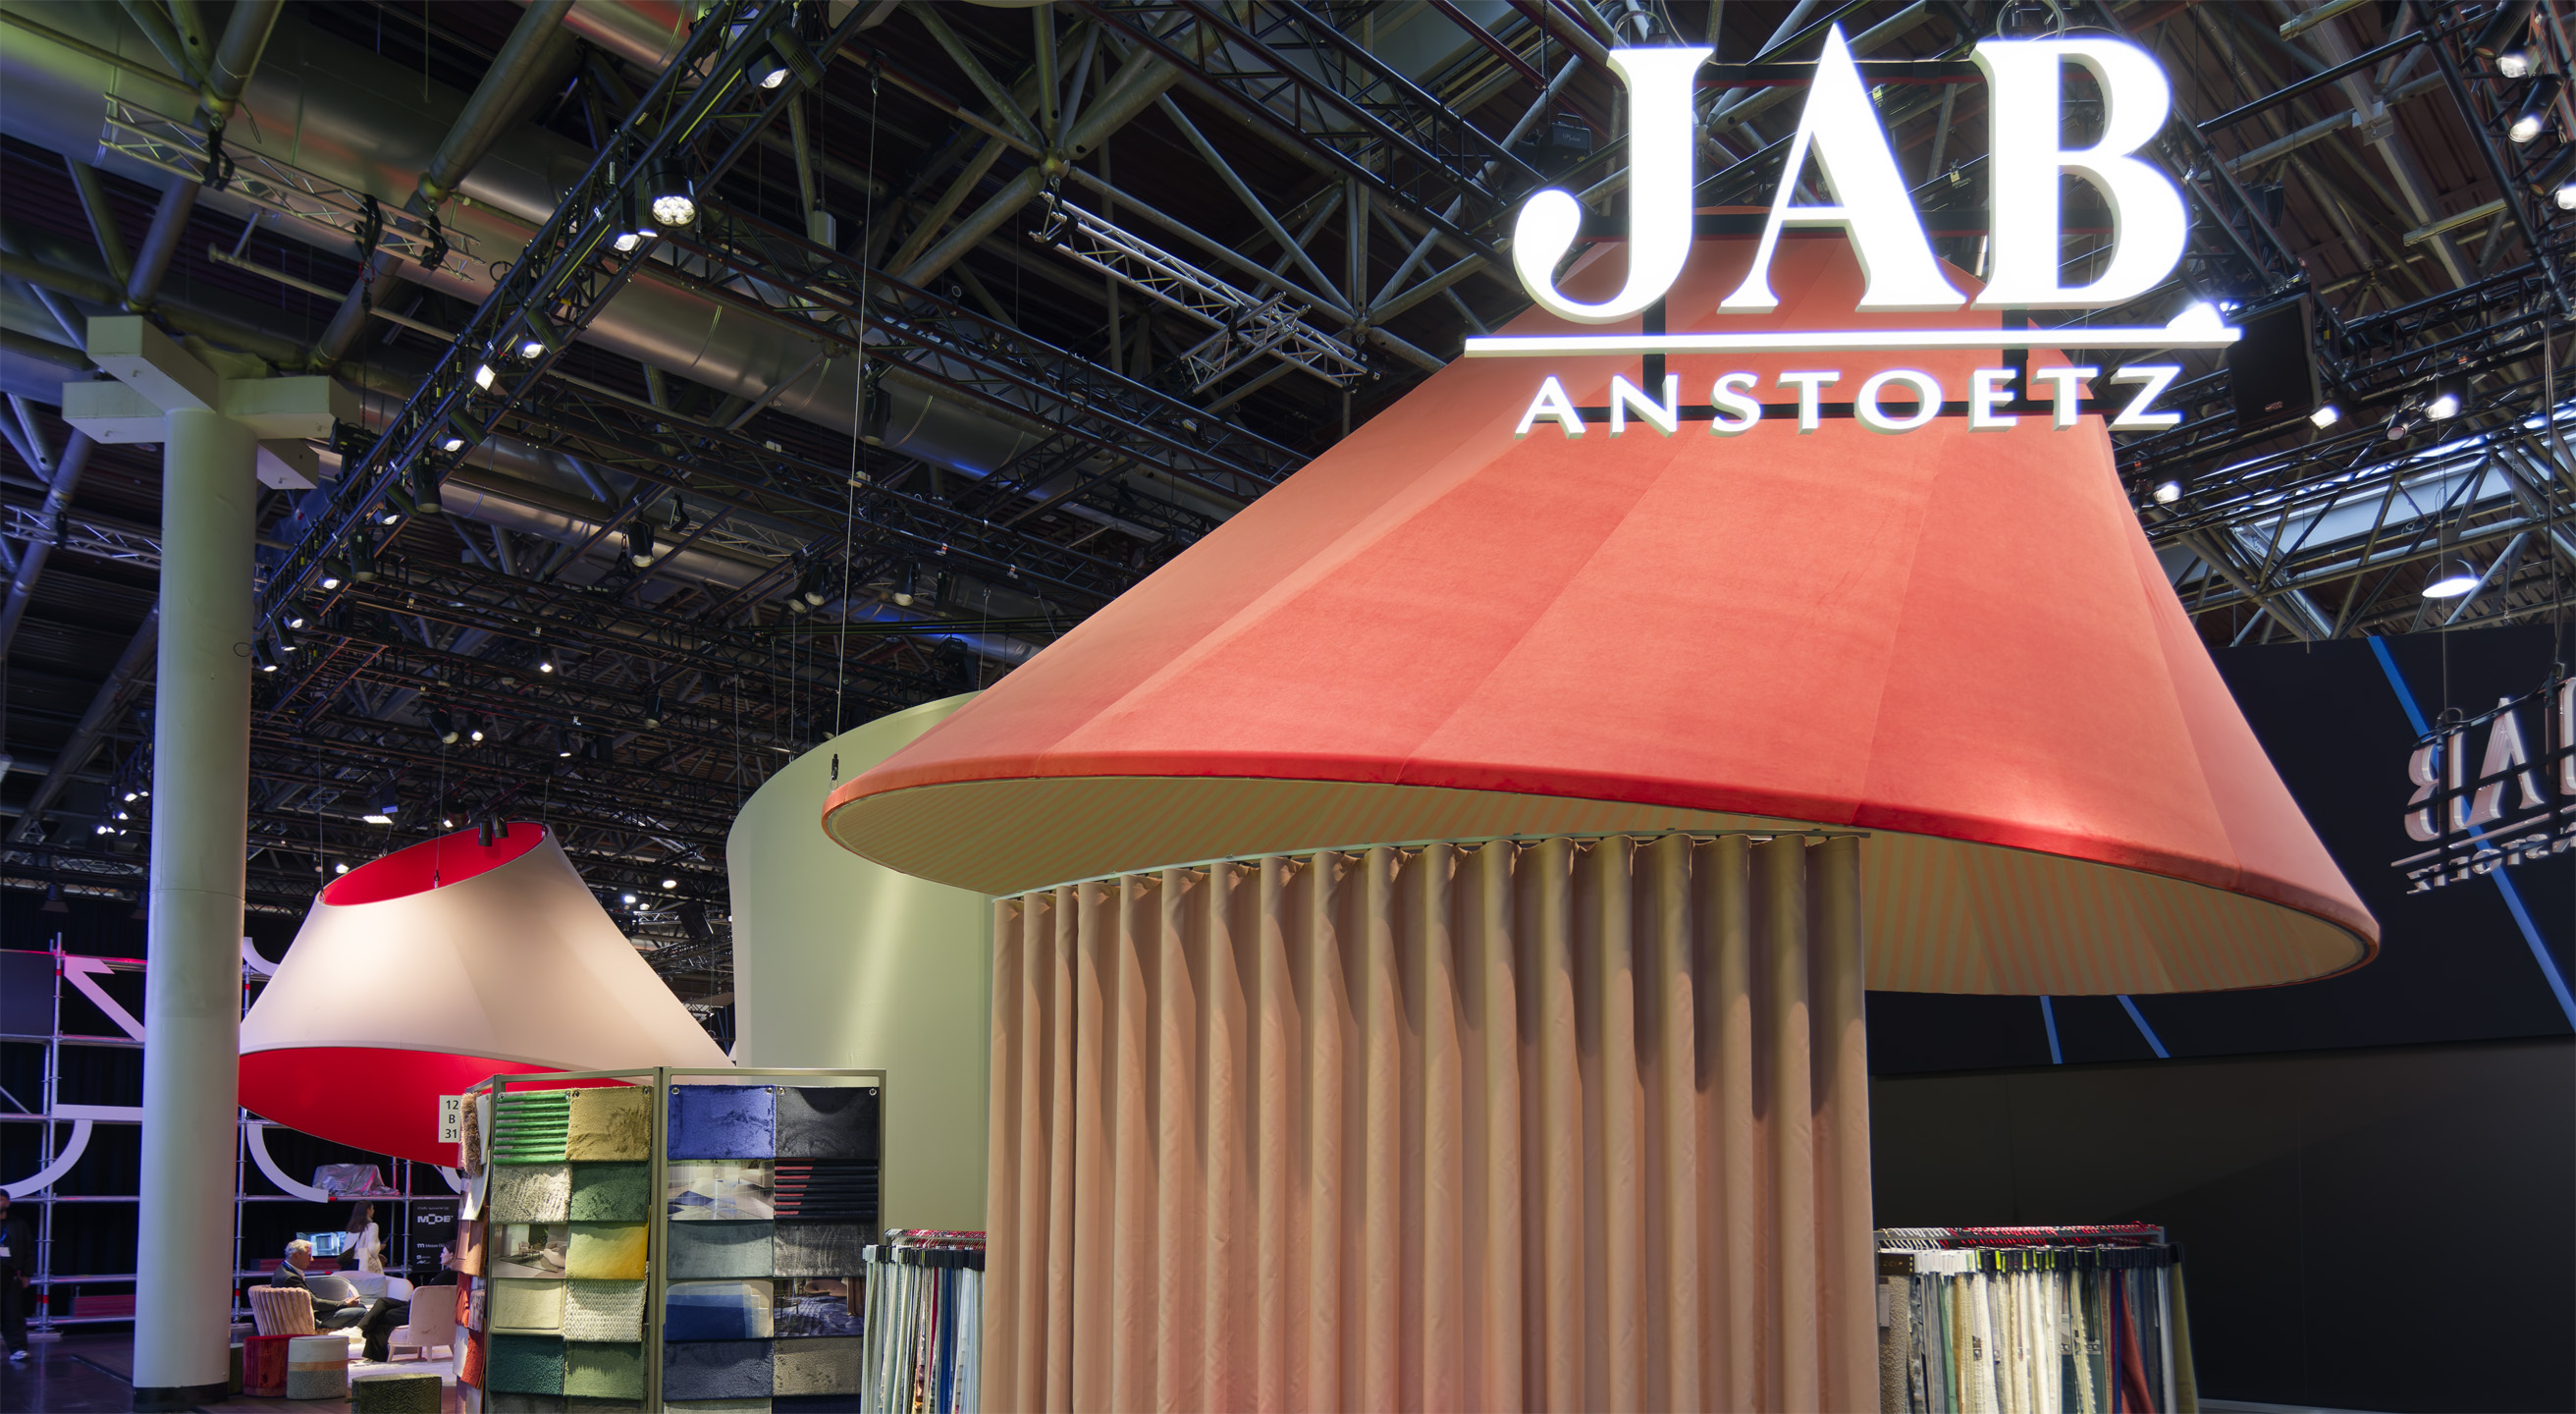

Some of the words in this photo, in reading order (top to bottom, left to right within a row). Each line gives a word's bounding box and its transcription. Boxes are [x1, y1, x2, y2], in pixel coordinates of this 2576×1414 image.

[1513, 25, 2189, 323] JAB
[1514, 364, 2183, 437] ANSTOETZ
[446, 1100, 458, 1110] 12
[449, 1115, 456, 1123] B
[445, 1129, 456, 1138] 31
